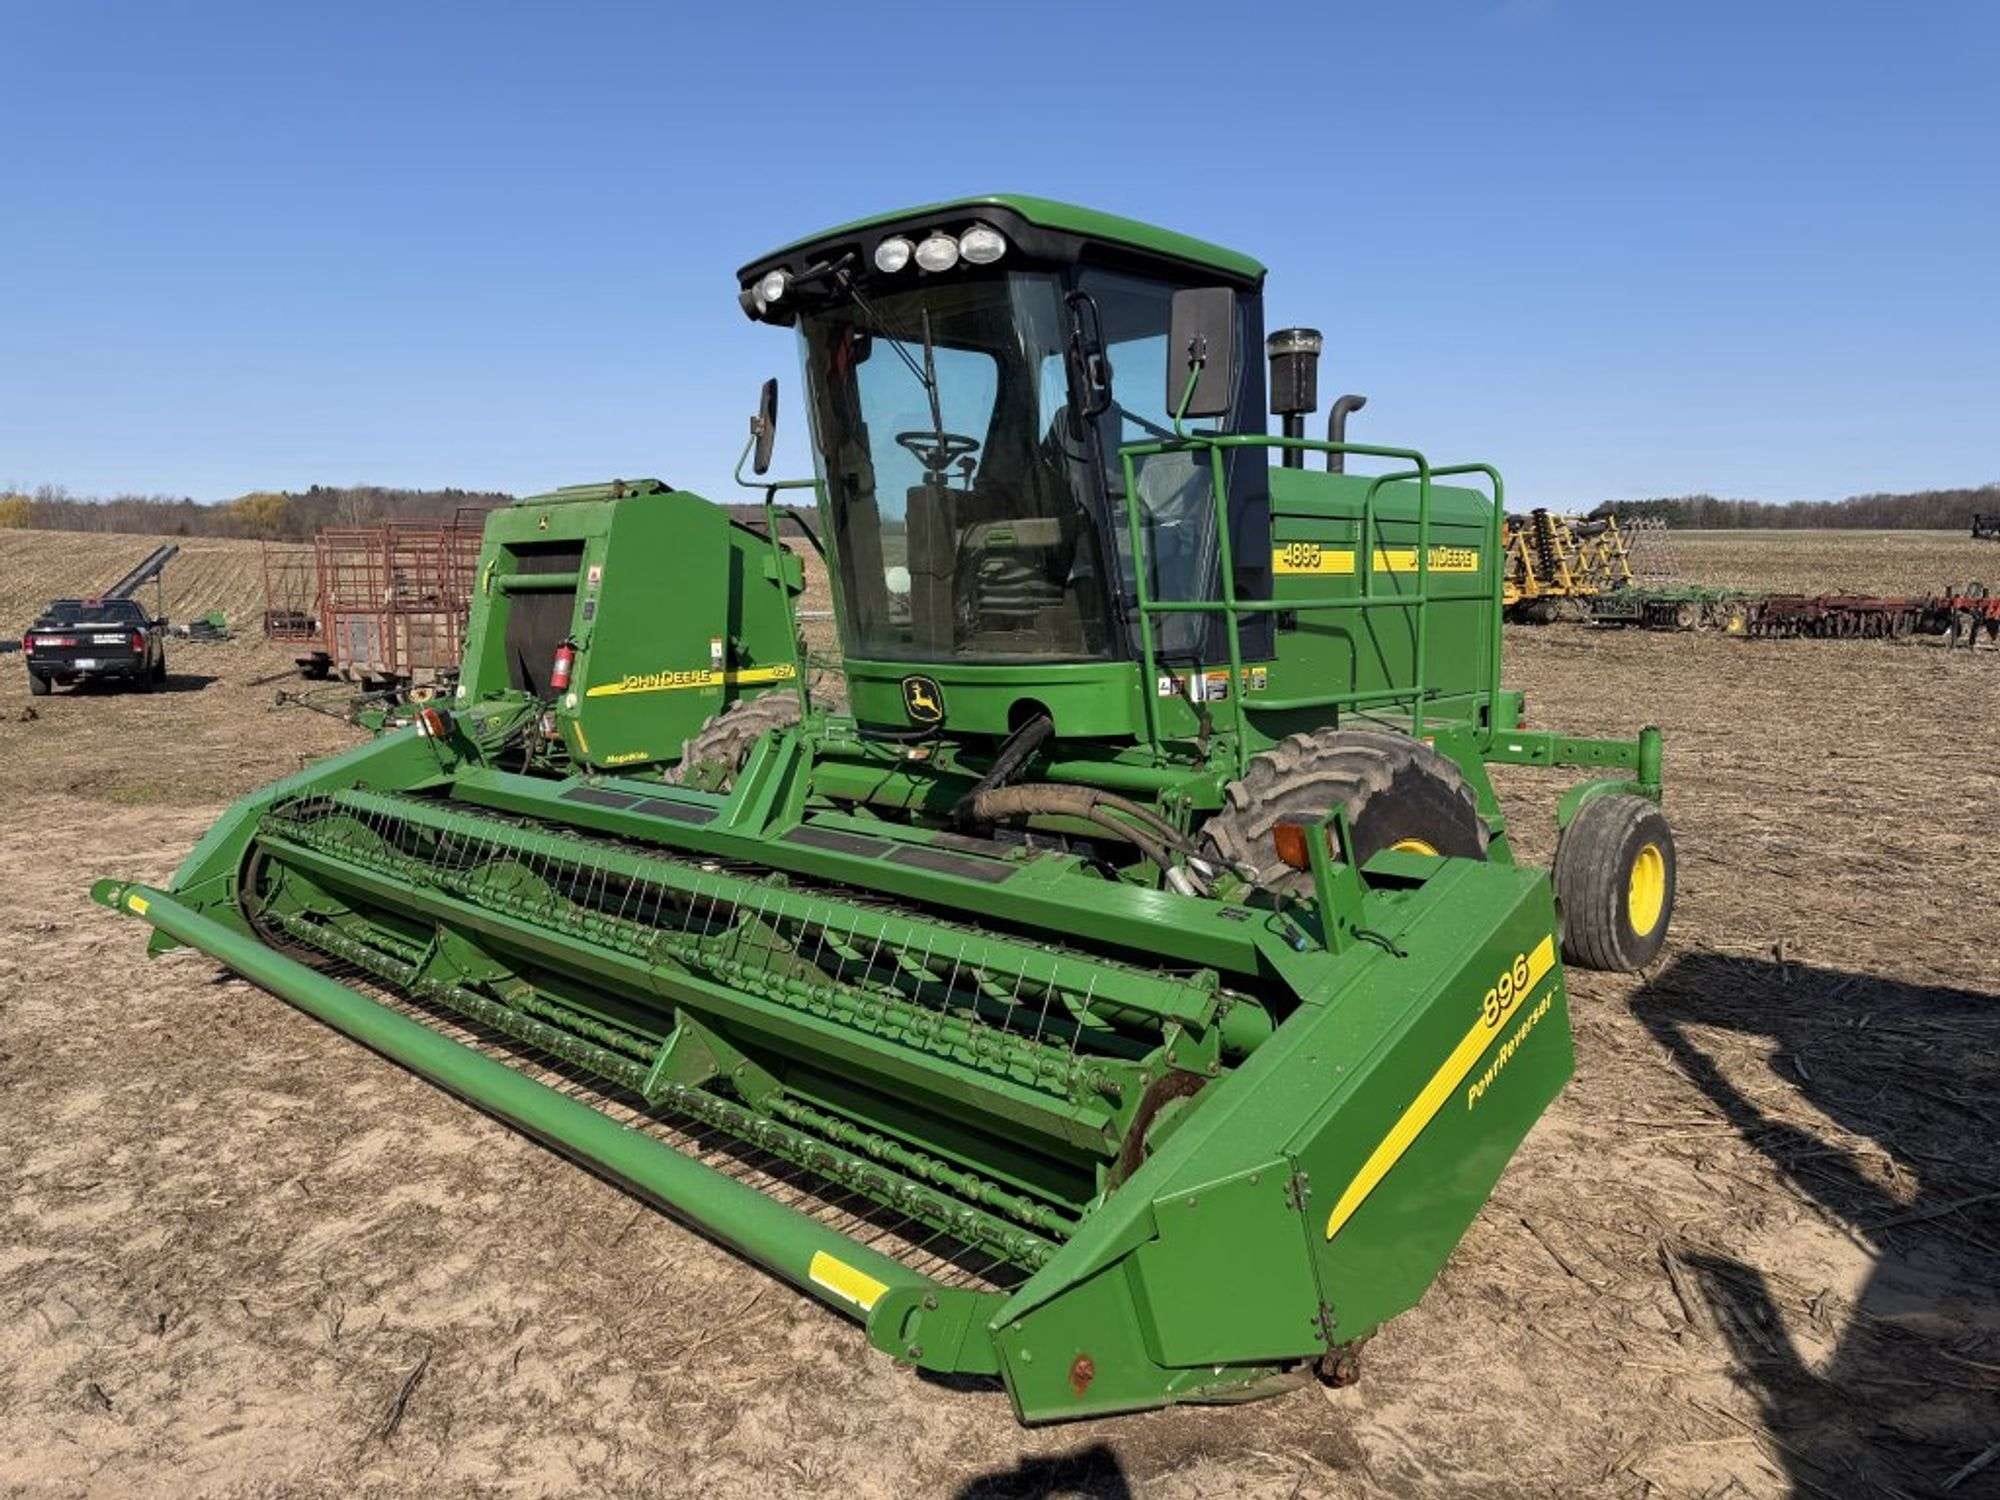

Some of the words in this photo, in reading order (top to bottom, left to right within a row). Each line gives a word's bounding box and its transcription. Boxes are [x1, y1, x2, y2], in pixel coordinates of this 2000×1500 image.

[1283, 543, 1322, 568] 4895
[621, 673, 661, 690] JOHN
[660, 669, 712, 686] DEERE
[1483, 953, 1530, 1028] 896
